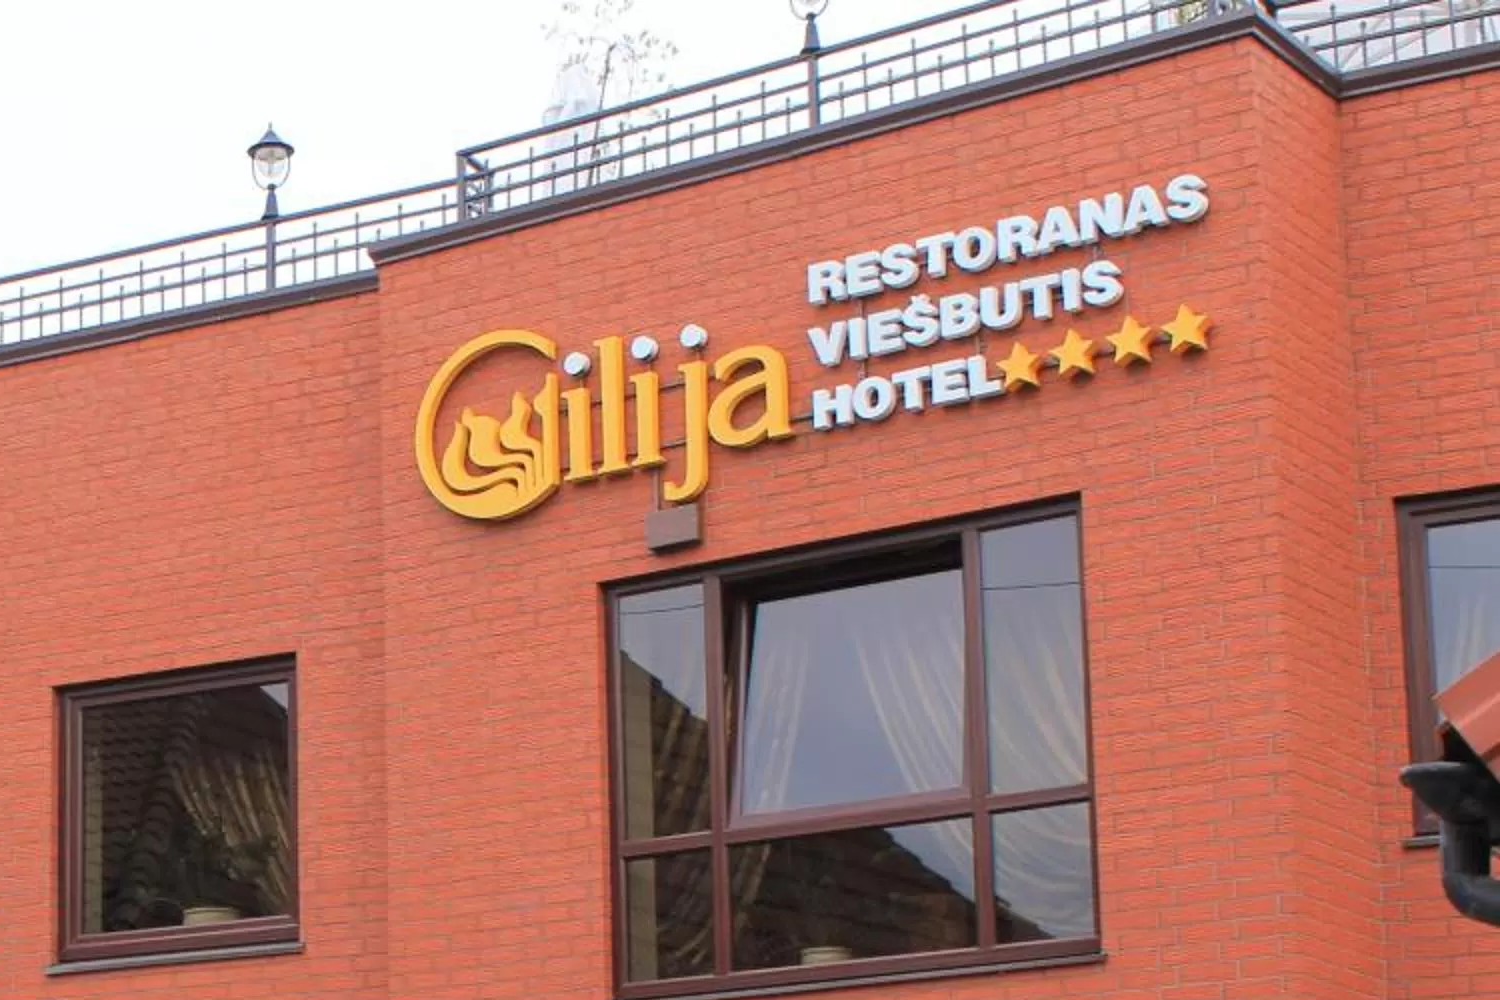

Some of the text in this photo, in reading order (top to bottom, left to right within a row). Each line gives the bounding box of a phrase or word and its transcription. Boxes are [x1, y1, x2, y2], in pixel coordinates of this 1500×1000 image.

[807, 174, 1209, 305] RESTORANAS
[807, 260, 1125, 367] VIEŠBUTIS
[415, 324, 793, 519] Gilija
[812, 355, 1005, 431] HOTEL
